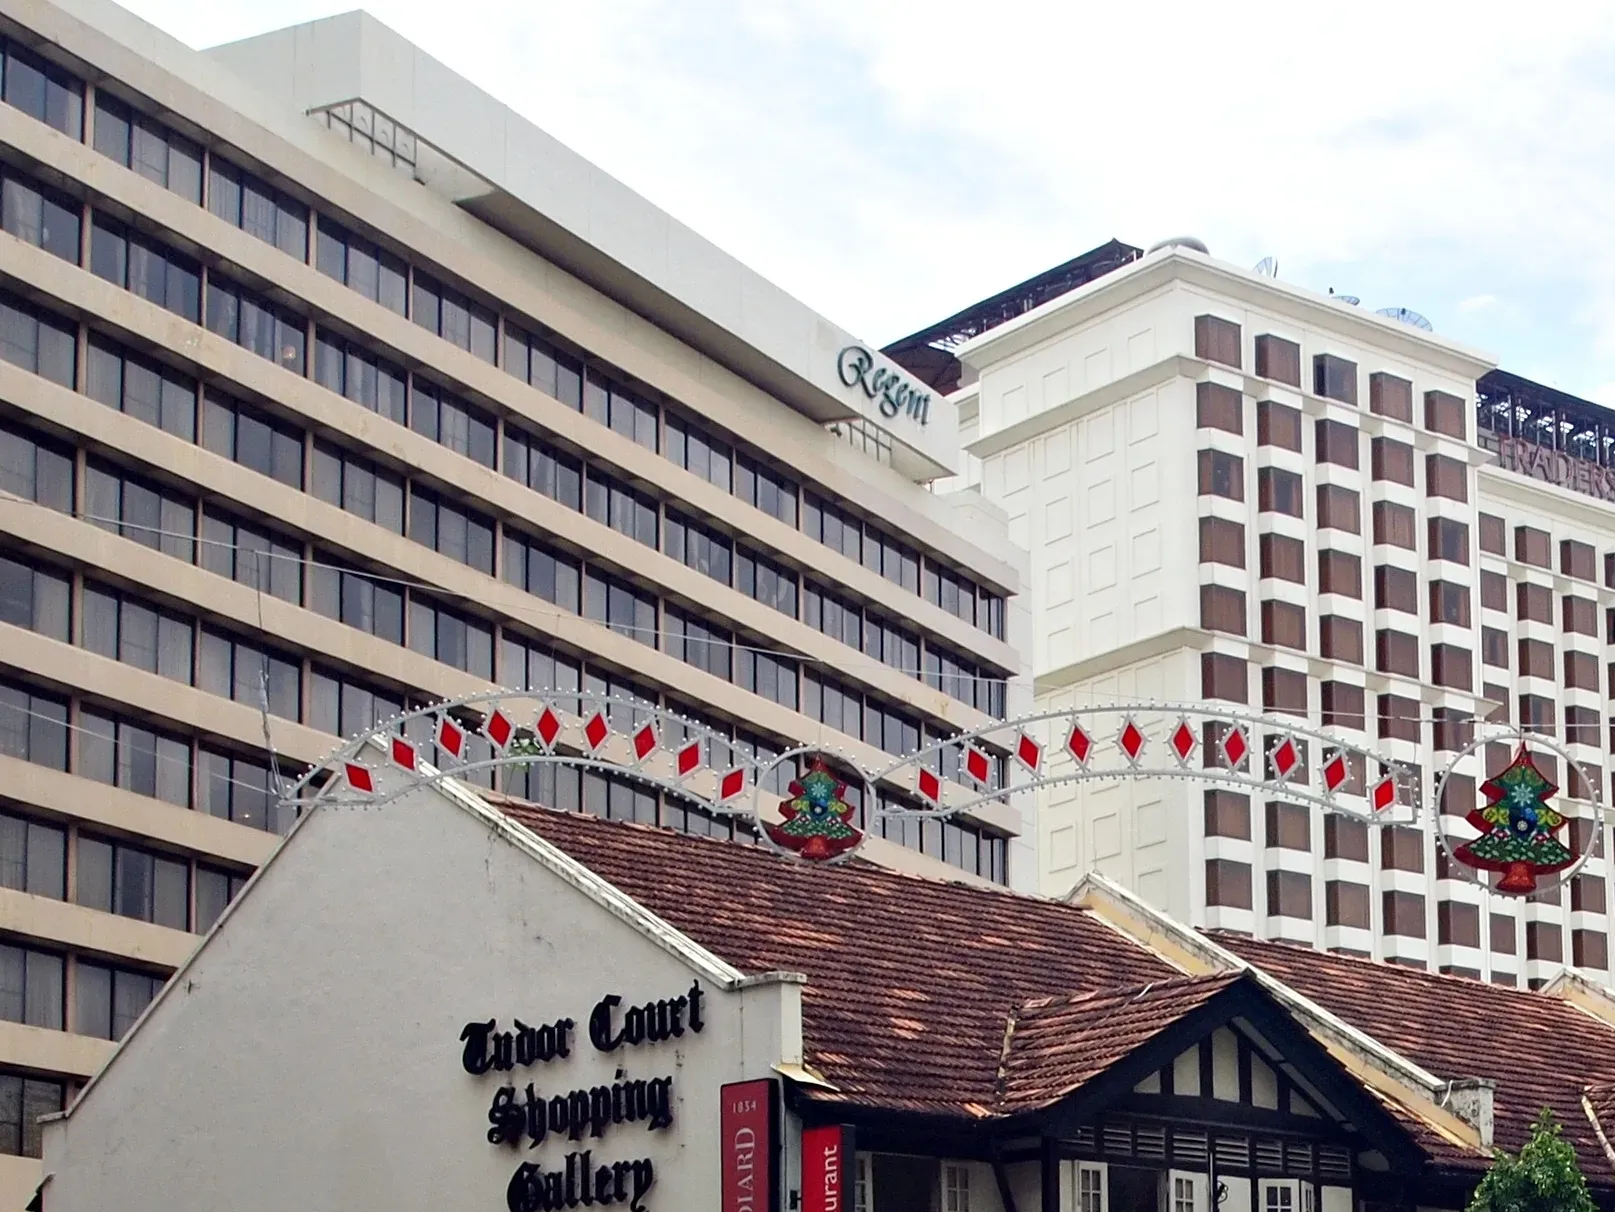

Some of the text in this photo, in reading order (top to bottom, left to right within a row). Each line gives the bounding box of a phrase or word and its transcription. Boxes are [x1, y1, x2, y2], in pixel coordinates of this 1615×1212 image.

[838, 346, 931, 427] Regent
[460, 979, 705, 1076] Tudor Court
[487, 1068, 673, 1150] Shopping
[732, 1101, 757, 1114] 1854
